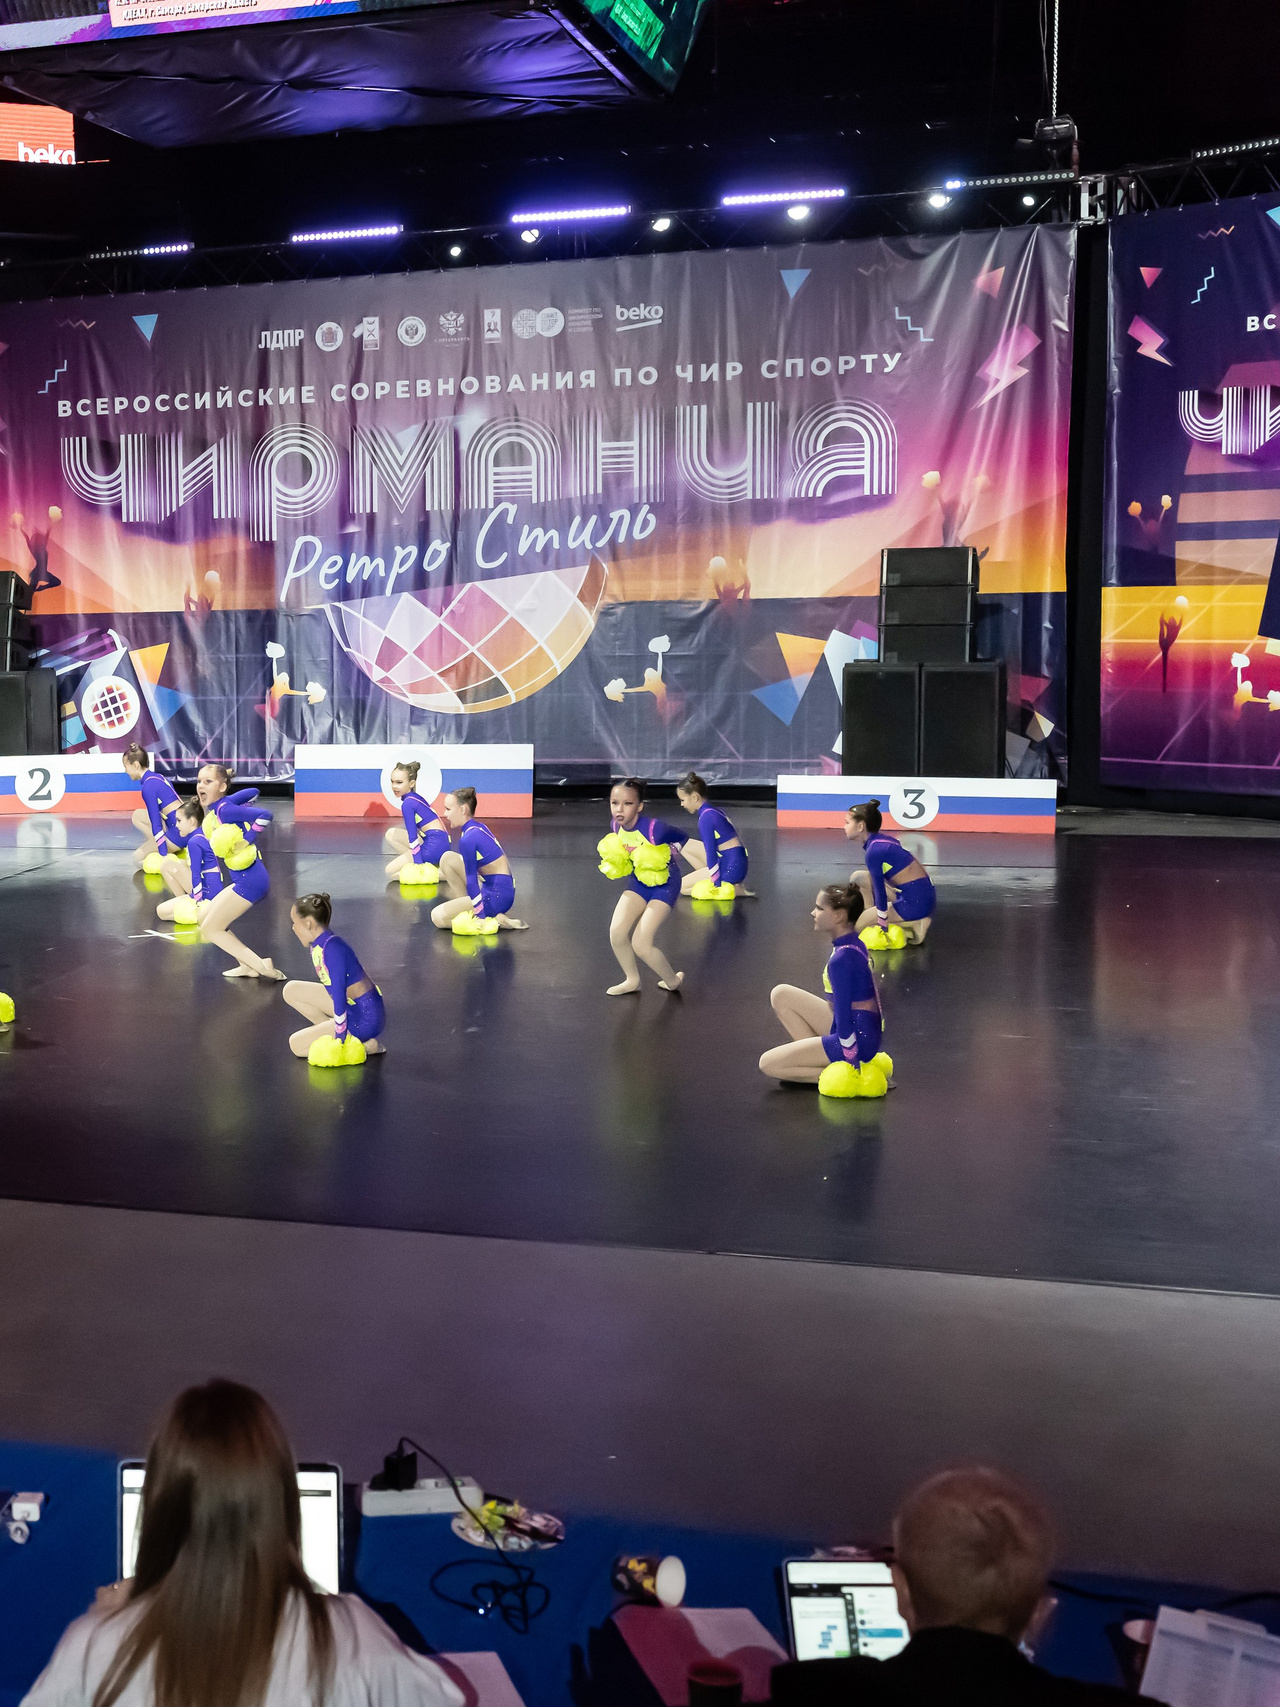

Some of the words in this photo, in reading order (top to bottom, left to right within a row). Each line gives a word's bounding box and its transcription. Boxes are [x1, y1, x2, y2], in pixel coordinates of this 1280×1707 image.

[17, 142, 76, 165] beko
[615, 303, 664, 321] beko
[258, 328, 305, 350] ЛДПР
[57, 384, 317, 418] ВСЕРОССИЙСКИЕ
[330, 369, 597, 403] СОРЕВНОВАНИЯ
[614, 366, 660, 386] ПО
[675, 361, 744, 384] ЧИР
[760, 352, 903, 379] СПОРТУ
[279, 534, 452, 603] Ретро
[475, 501, 658, 569] Стиль
[28, 767, 52, 801] 2
[902, 788, 926, 820] 3
